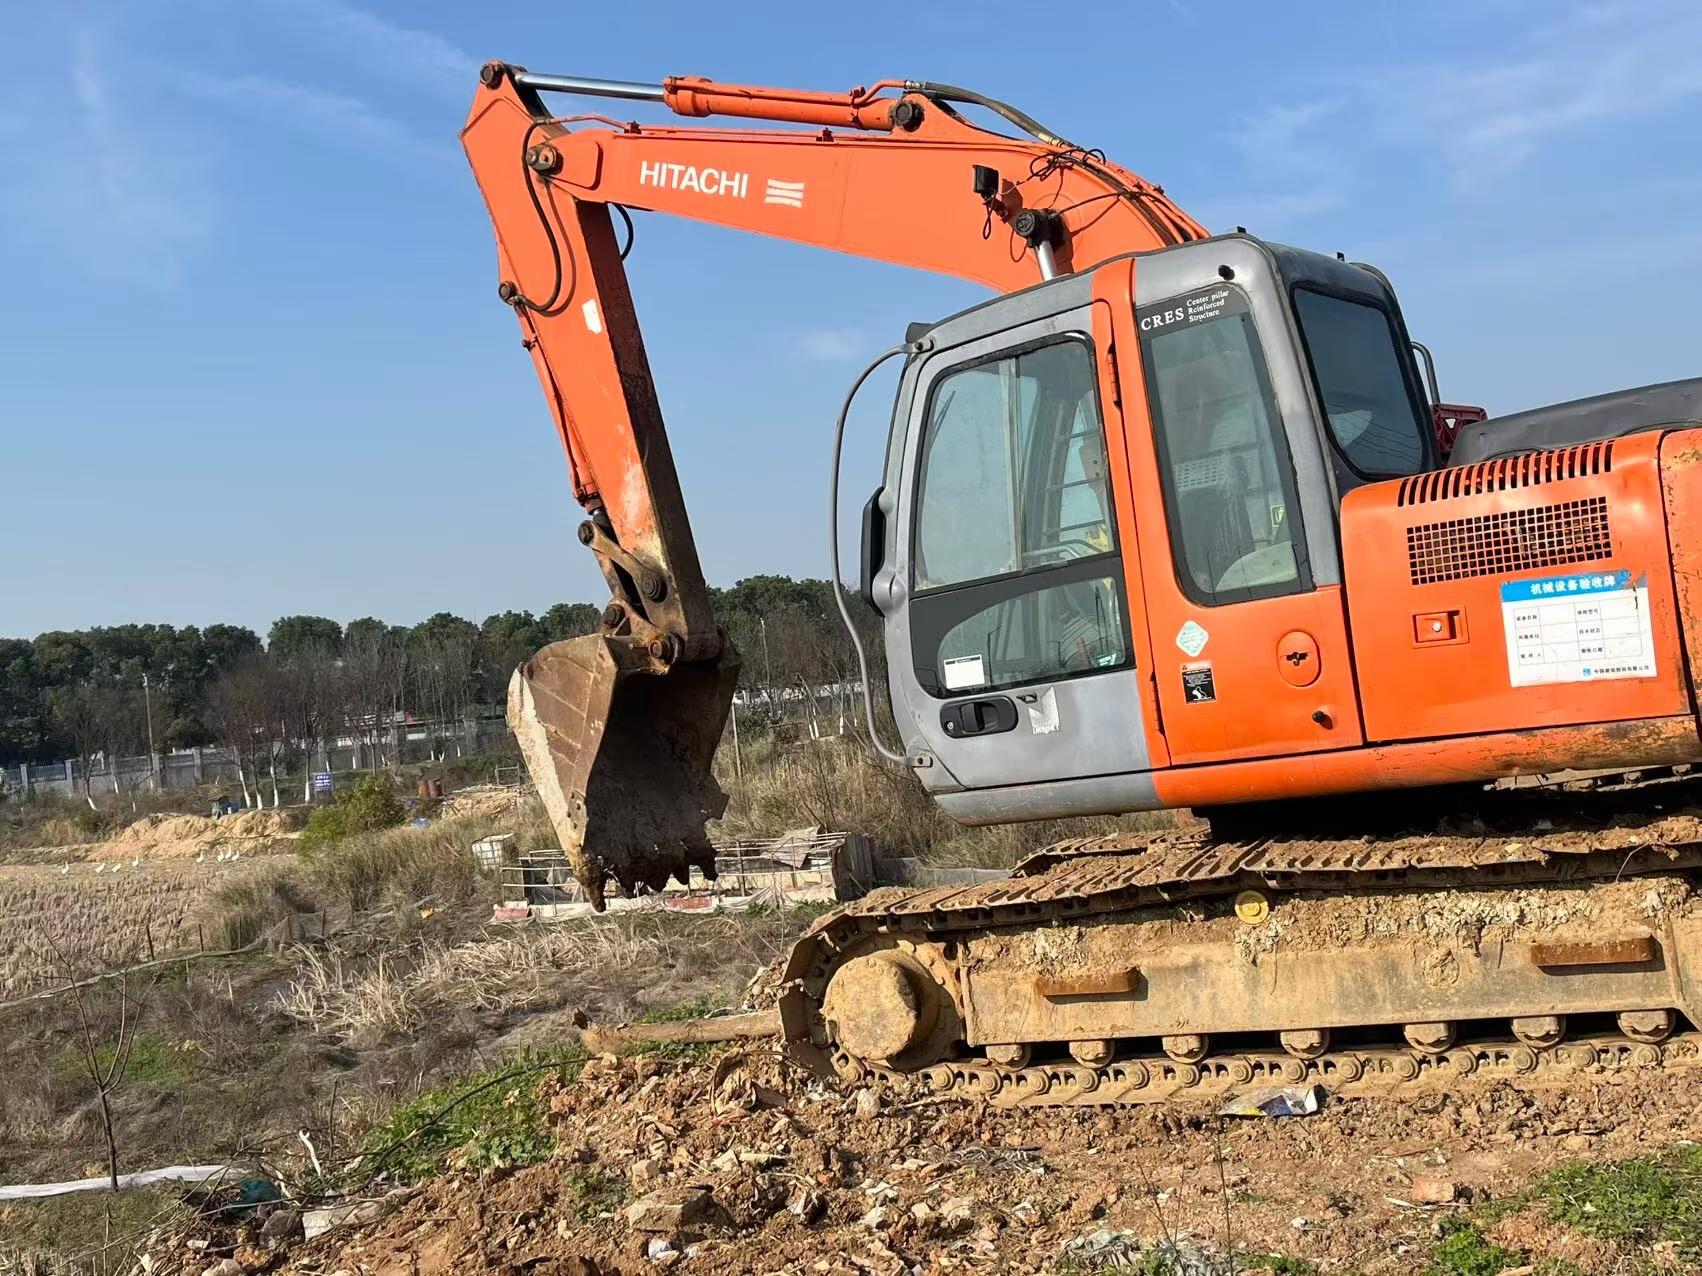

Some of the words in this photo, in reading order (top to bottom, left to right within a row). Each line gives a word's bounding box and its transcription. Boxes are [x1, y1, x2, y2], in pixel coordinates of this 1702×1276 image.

[640, 160, 749, 198] HITACHI
[1186, 295, 1209, 307] Center
[1188, 298, 1225, 315] Reinforced
[1141, 307, 1185, 331] CRES
[1189, 309, 1220, 323] Structure
[1530, 574, 1616, 595] 机械设备验收牌
